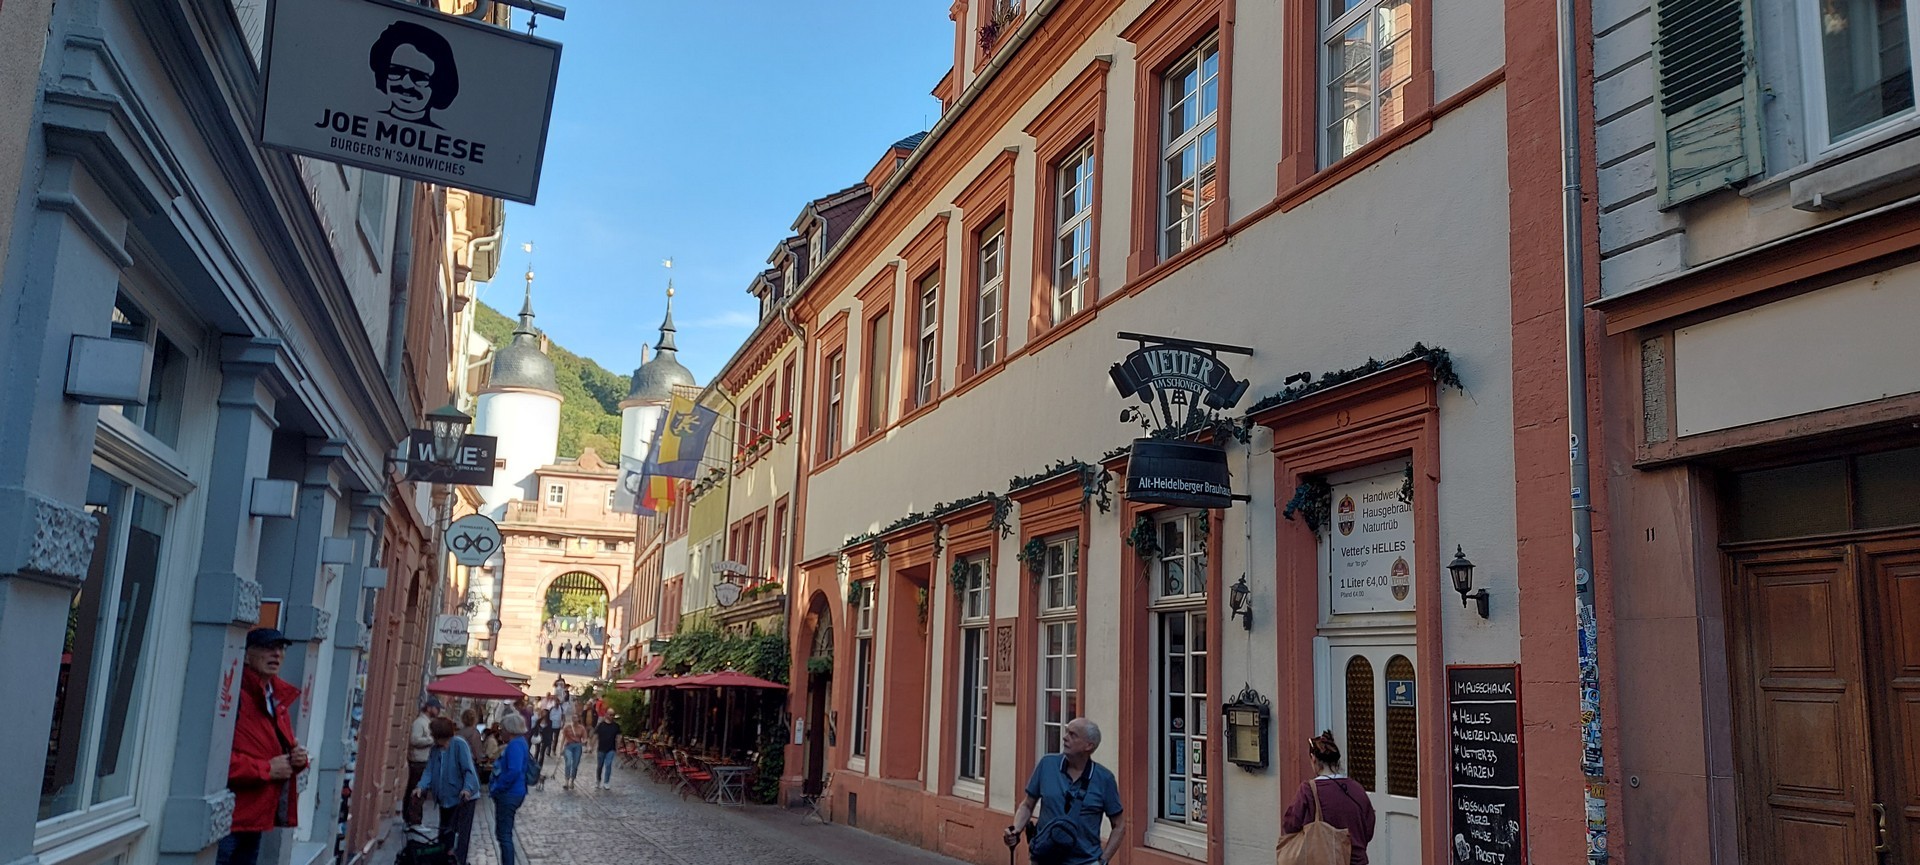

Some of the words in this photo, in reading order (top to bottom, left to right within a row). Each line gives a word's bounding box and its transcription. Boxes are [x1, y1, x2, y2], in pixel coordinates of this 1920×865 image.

[314, 109, 369, 138] JOE
[375, 121, 486, 164] MOLESE
[1143, 350, 1214, 384] VETTER
[1138, 477, 1204, 494] Alt-Heidelberger
[1362, 503, 1412, 518] Hausgebraut
[1362, 519, 1398, 533] Naturtrüb
[1645, 527, 1655, 542] 11
[1341, 545, 1370, 557] Vetter's
[1372, 540, 1406, 554] HELLES
[1340, 579, 1345, 589] 1
[1347, 577, 1365, 588] Liter
[1366, 575, 1388, 588] €4,00
[1466, 681, 1512, 695] AUSSCHANK
[1460, 708, 1492, 725] HELLES
